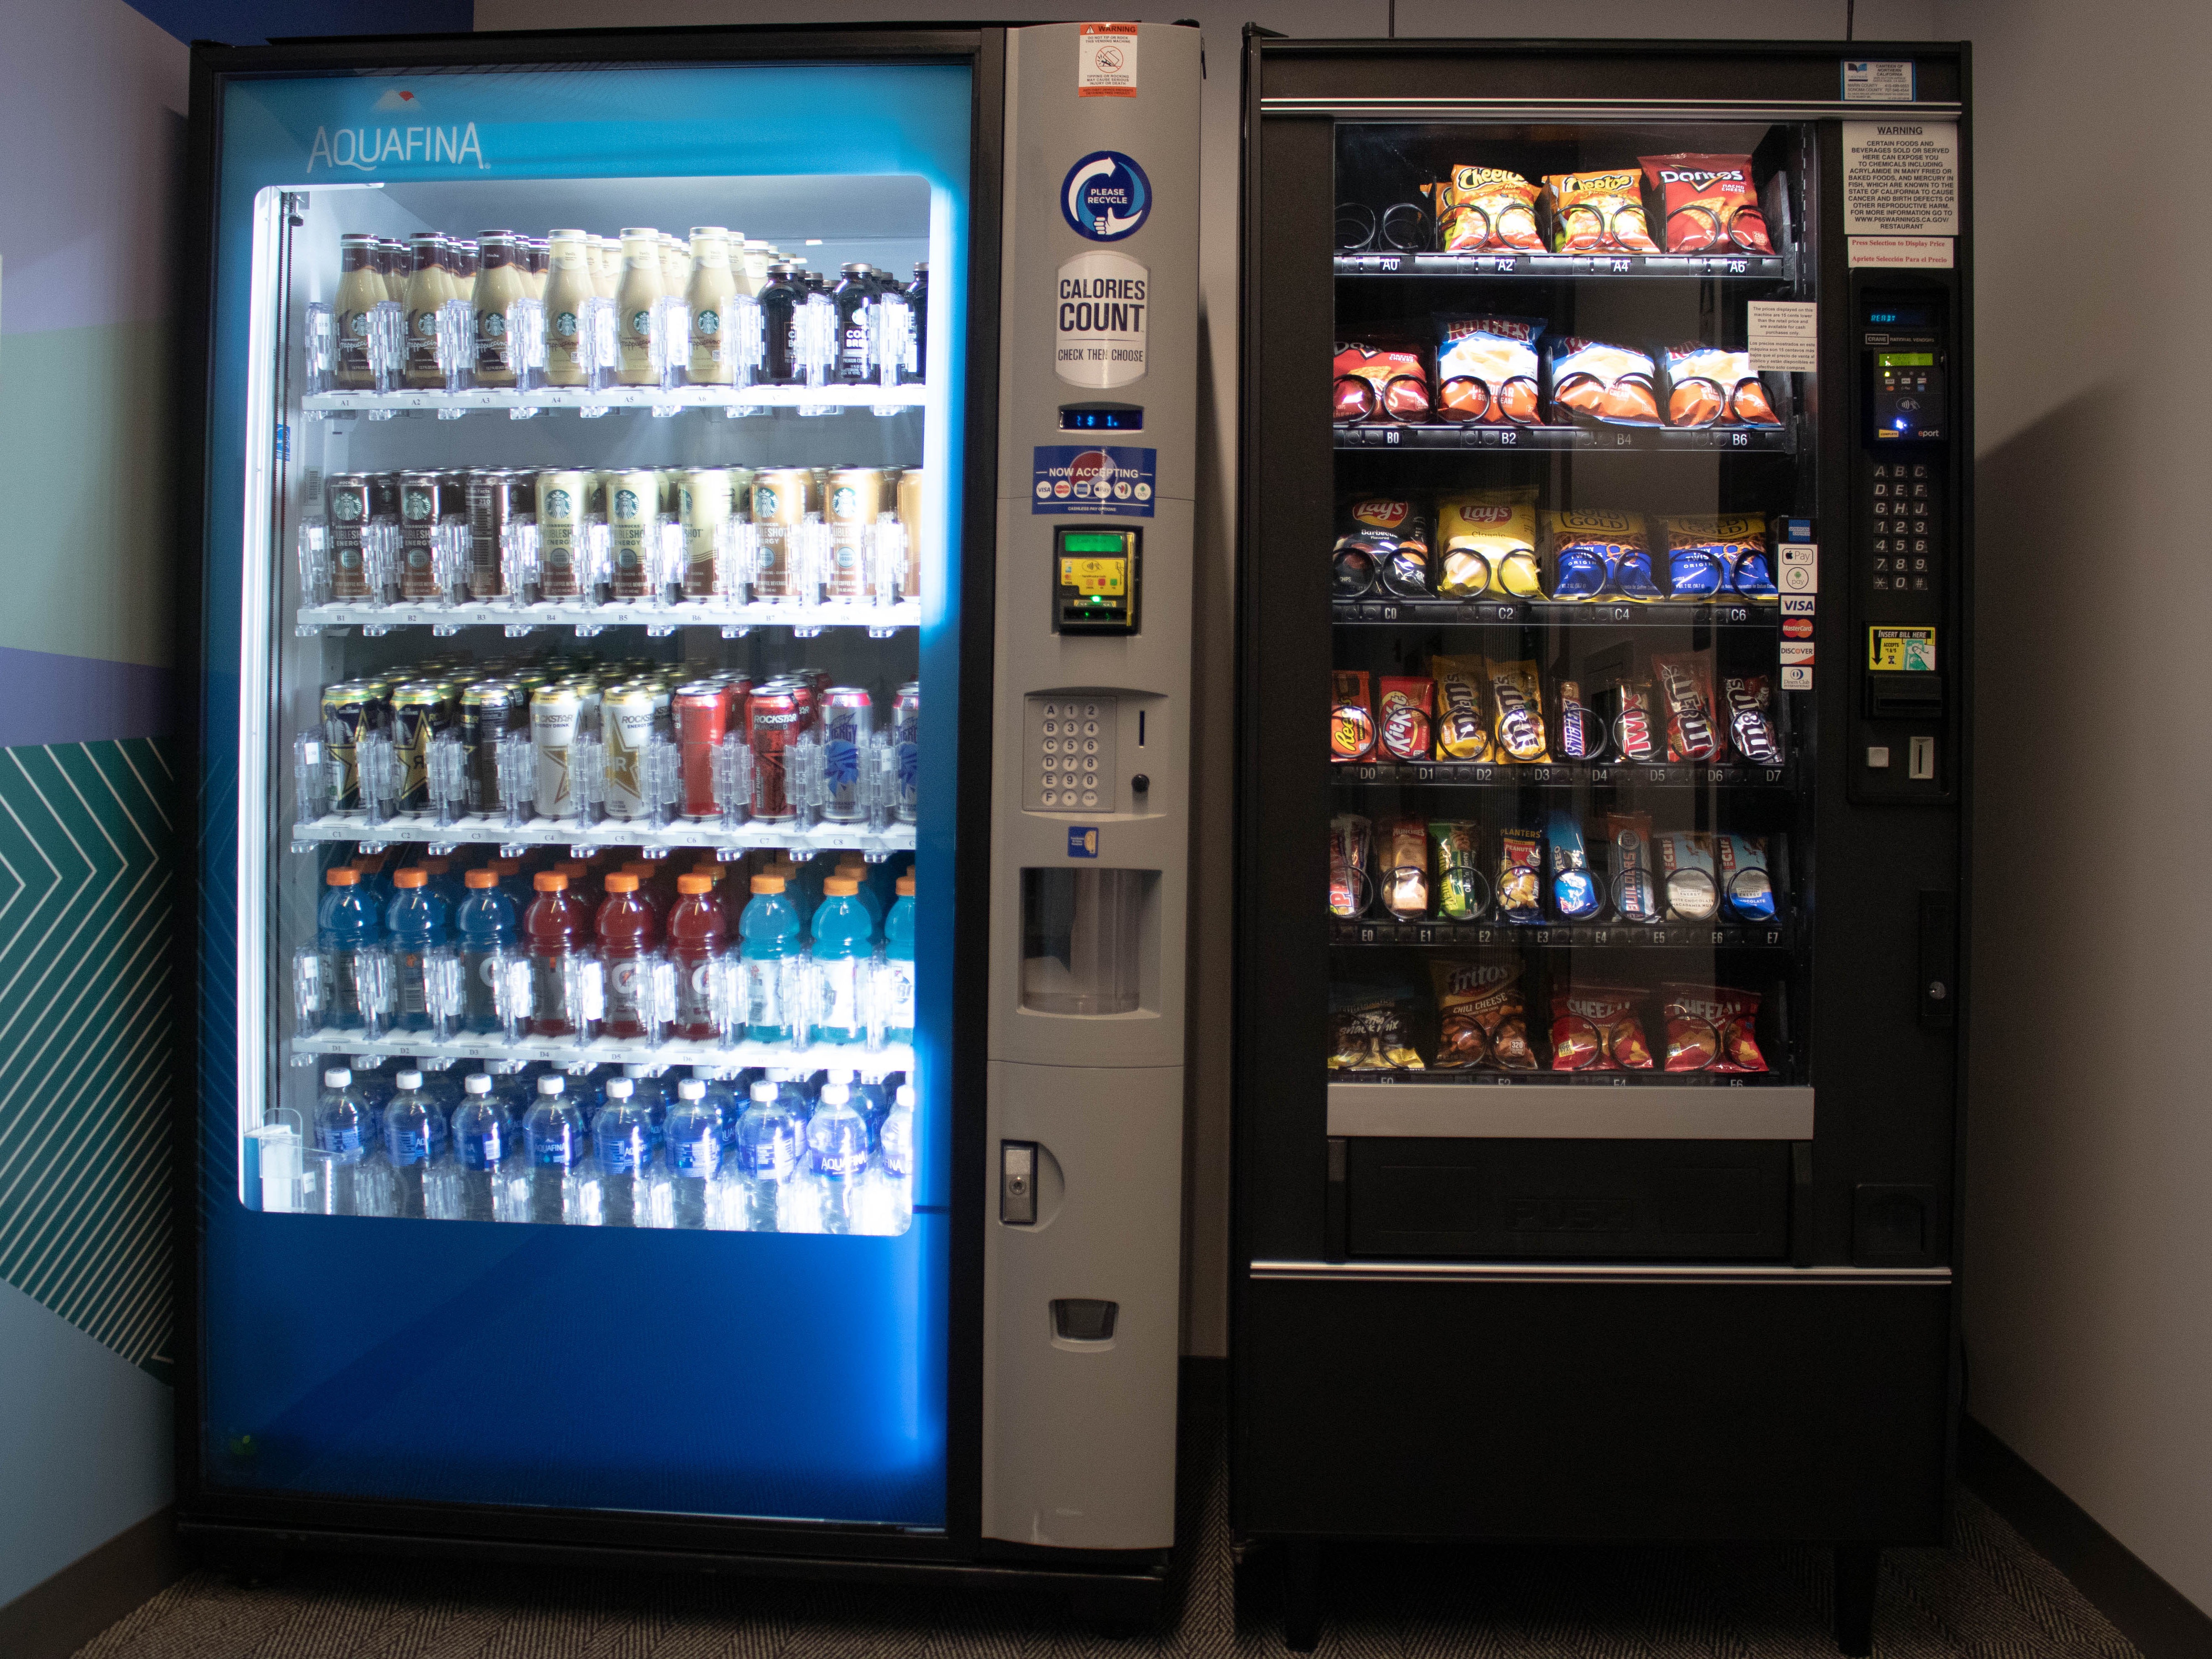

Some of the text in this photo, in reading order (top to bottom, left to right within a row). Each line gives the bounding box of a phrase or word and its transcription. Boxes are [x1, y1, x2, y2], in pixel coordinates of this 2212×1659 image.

[307, 122, 484, 173] AQUAFINA
[1660, 171, 1743, 182] Doritos
[1563, 175, 1632, 192] Cheetos
[1383, 260, 1398, 270] A0
[1497, 260, 1512, 271] A2
[1613, 261, 1629, 271] A4
[1730, 262, 1745, 272] A6
[1060, 279, 1145, 299] CALORIES
[1060, 302, 1145, 332] COUNT
[1449, 320, 1529, 343] RUFFLES
[1058, 349, 1143, 362] CHECK THEN CHOOSE
[1387, 432, 1399, 443] B0
[1502, 433, 1516, 444] B2
[1617, 434, 1631, 445] B4
[1733, 434, 1747, 445] B6
[1076, 468, 1138, 478] ACCEPTING
[1355, 501, 1406, 520] Lay's
[1464, 506, 1510, 523] Lay's
[1570, 518, 1623, 529] GOLD
[1361, 530, 1398, 538] Barbecue
[1795, 551, 1810, 562] Pay
[1784, 601, 1813, 611] VISA
[1385, 608, 1397, 618] C0
[1499, 608, 1513, 620] C2
[1615, 609, 1629, 620] C4
[1731, 609, 1746, 620] C6
[754, 714, 796, 723] ROCKSTAR
[1563, 700, 1582, 757] SNICKERS
[1624, 694, 1651, 757] TWIX
[1361, 768, 1375, 779] D0
[1477, 769, 1491, 781] D2
[1593, 770, 1607, 781] D4
[1708, 771, 1723, 781] D6
[1501, 829, 1541, 838] PLANTERS
[1721, 838, 1732, 861] CLIF
[1624, 852, 1640, 911] BUILDERS
[1421, 931, 1430, 941] E1
[1538, 932, 1548, 942] E3
[1654, 932, 1665, 943] E5
[1767, 932, 1778, 943] E7
[1453, 993, 1507, 1013] CHILI CHEESE
